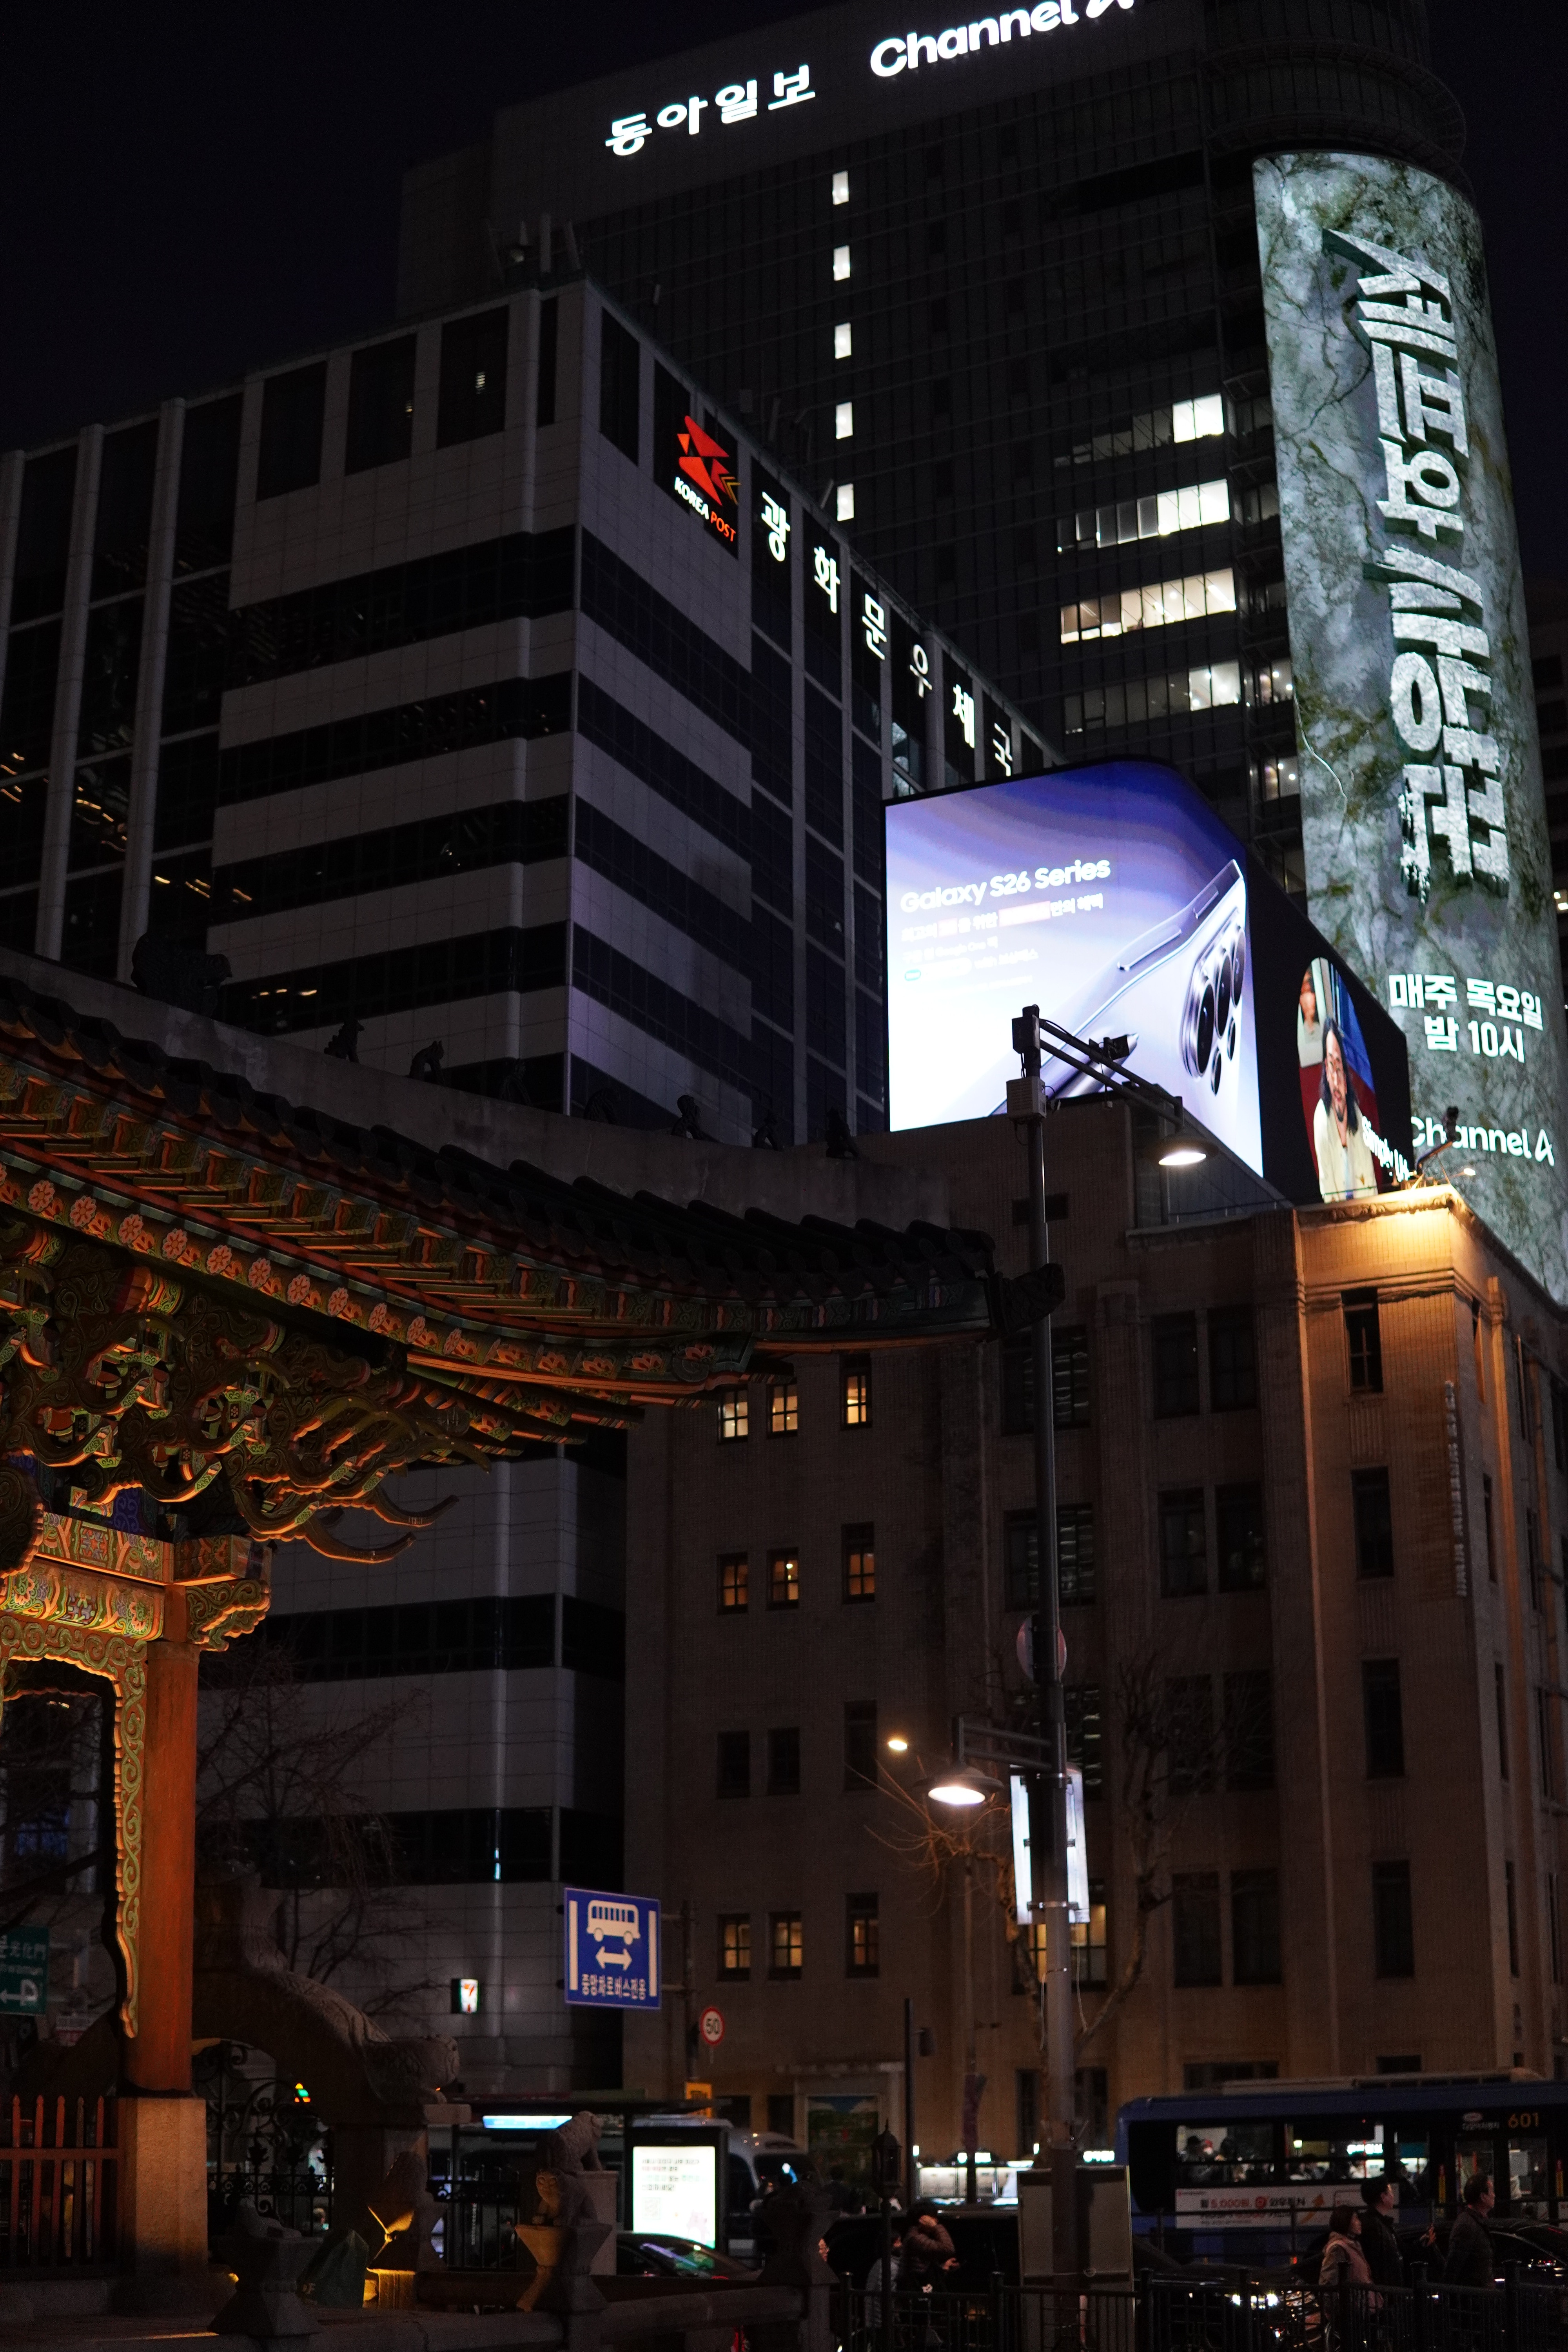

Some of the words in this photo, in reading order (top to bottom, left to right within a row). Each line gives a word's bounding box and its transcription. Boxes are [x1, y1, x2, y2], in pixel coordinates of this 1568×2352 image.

[871, 0, 1079, 77] Channel
[606, 65, 815, 156] 동아일보
[675, 477, 709, 520] KOREA
[711, 511, 736, 542] POST
[900, 882, 987, 913] Galaxy
[990, 871, 1031, 897] S26
[1034, 859, 1111, 889] Series
[1388, 974, 1458, 1010] 매주
[1467, 978, 1543, 1031] 목요일
[1424, 1016, 1459, 1052] 밤
[1468, 1020, 1524, 1063] 10시
[1411, 1116, 1532, 1159] Channel
[1535, 1129, 1555, 1166] A
[706, 2018, 721, 2035] 50
[1507, 2111, 1540, 2129] 601
